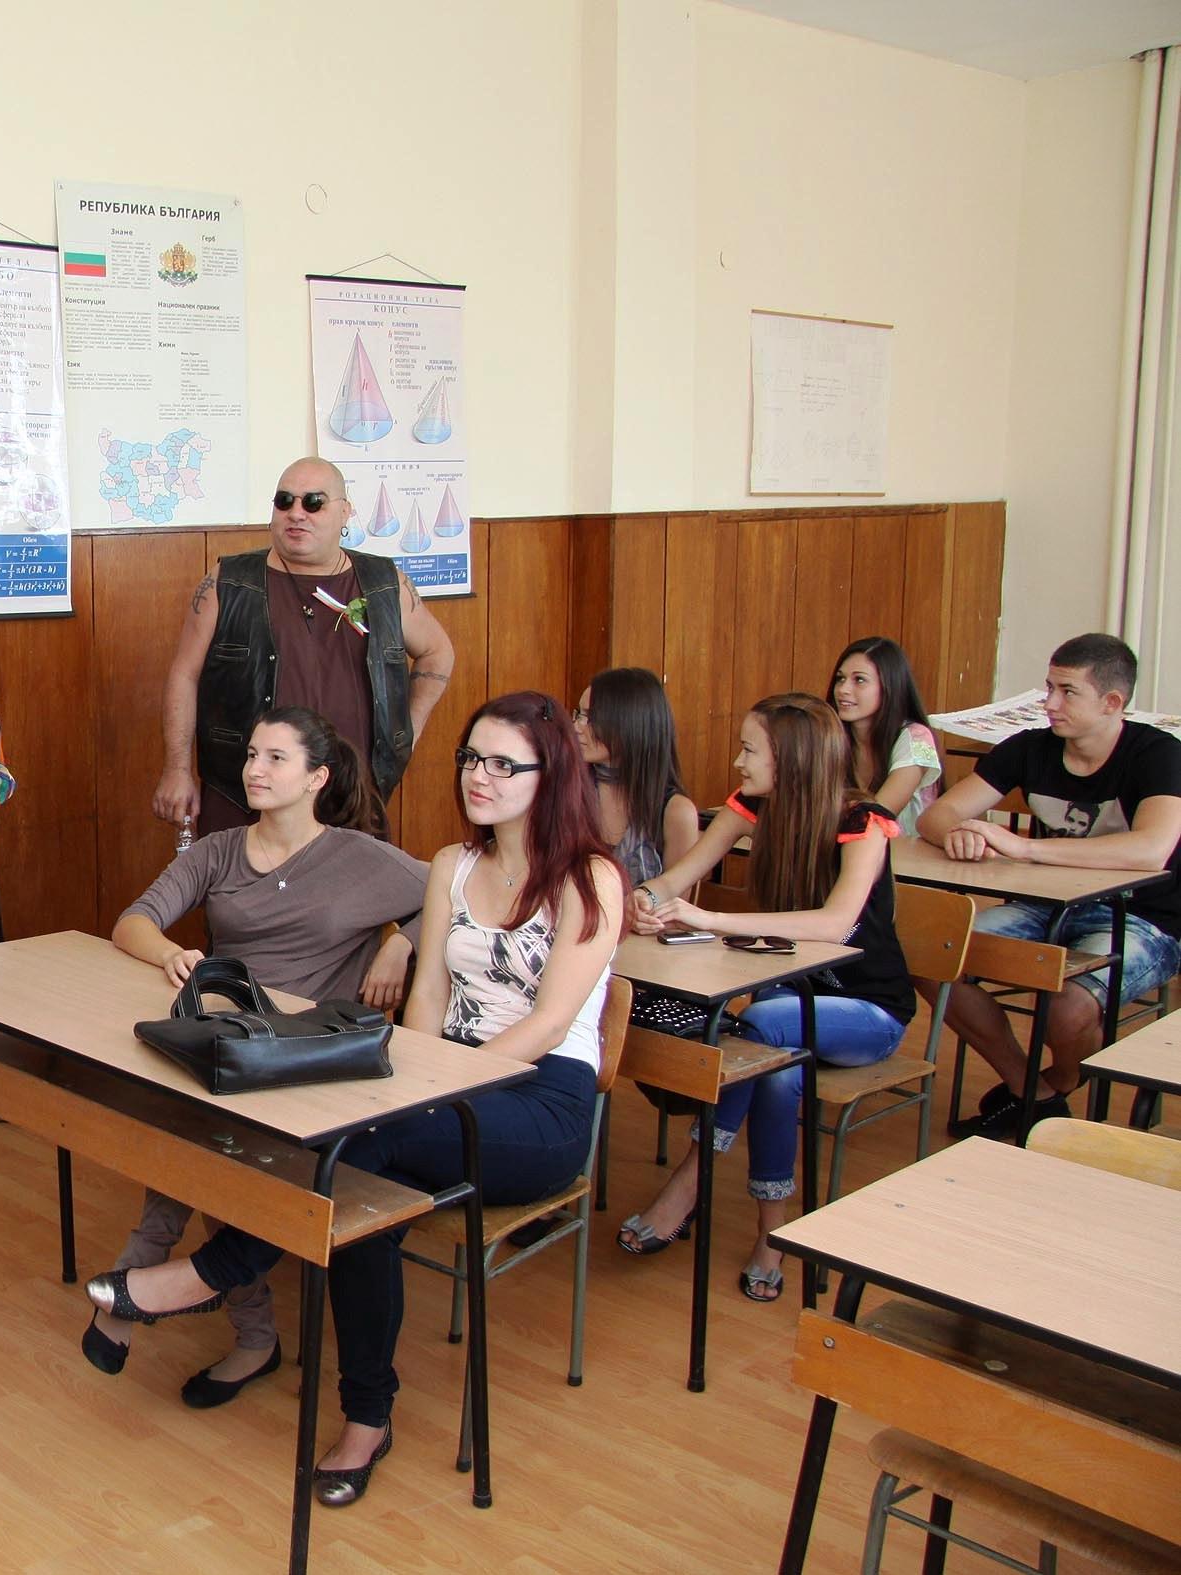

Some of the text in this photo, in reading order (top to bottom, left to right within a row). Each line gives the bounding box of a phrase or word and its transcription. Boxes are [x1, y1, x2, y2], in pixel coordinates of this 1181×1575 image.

[80, 200, 220, 222] РЕПУБЛИКА БЪЛГАРИЯ
[110, 228, 133, 236] Знаме
[201, 235, 216, 243] Герб
[65, 297, 106, 306] Конституция
[157, 301, 220, 311] Национален празник
[373, 304, 408, 314] КОНУС
[66, 360, 81, 368] Език
